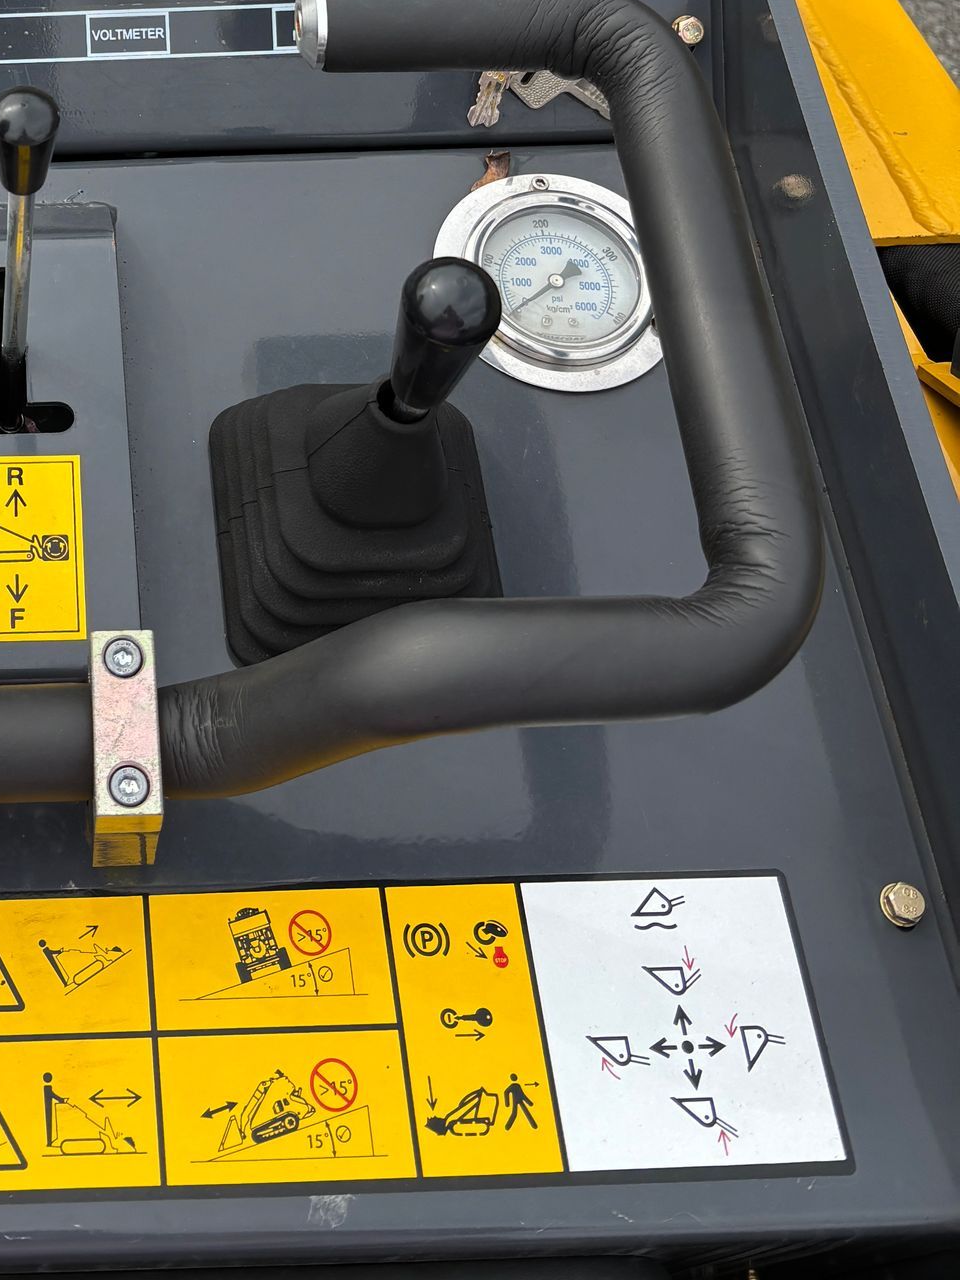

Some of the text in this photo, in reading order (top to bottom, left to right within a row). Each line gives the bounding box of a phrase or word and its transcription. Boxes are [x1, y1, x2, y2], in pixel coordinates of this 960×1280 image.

[92, 27, 165, 41] VOLTMETER
[532, 219, 549, 229] 200
[540, 245, 562, 256] 3000
[602, 246, 618, 262] 300
[483, 253, 495, 267] 100
[515, 257, 537, 267] 2000
[511, 277, 532, 287] 1000
[579, 282, 601, 291] 5000
[551, 294, 563, 304] psi
[575, 302, 598, 312] 6000
[7, 467, 24, 486] R
[10, 608, 26, 629] F
[420, 930, 434, 950] P
